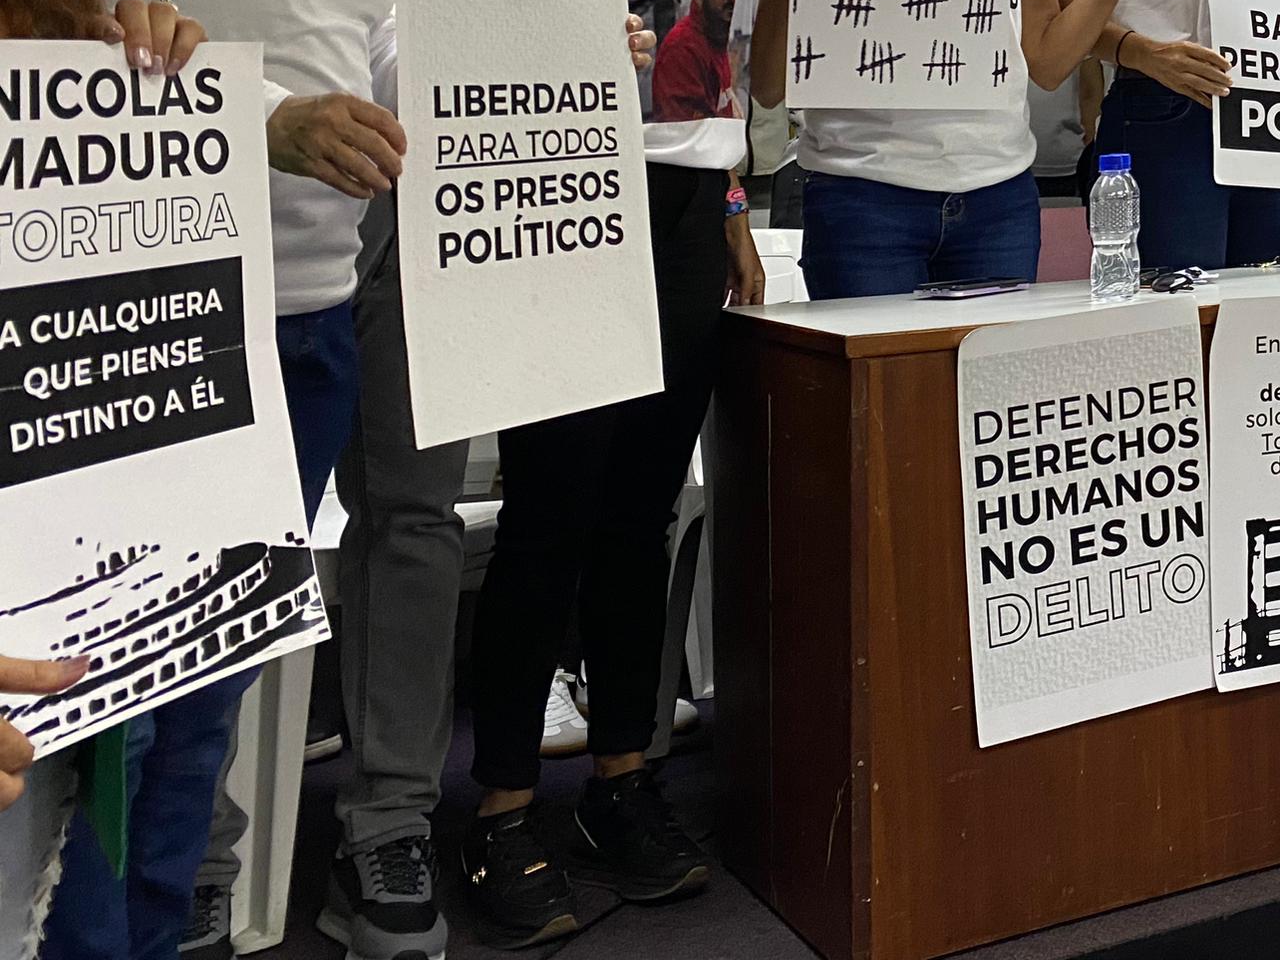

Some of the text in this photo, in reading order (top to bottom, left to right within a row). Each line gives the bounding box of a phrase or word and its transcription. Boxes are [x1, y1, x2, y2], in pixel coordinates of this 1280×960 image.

[433, 81, 618, 119] LIBERDADE
[436, 127, 617, 163] PARA TODOS
[435, 170, 620, 216] OS PRESOS
[438, 213, 623, 268] POLÍTICOS
[23, 337, 203, 400] QUE PIENSE
[1255, 336, 1280, 354] En
[10, 377, 224, 453] DISTINTO A ÉL
[974, 376, 1196, 446] DEFENDER
[974, 417, 1200, 489] DERECHOS
[977, 458, 1200, 534] HUMANOS
[986, 553, 1206, 649] DELITO
